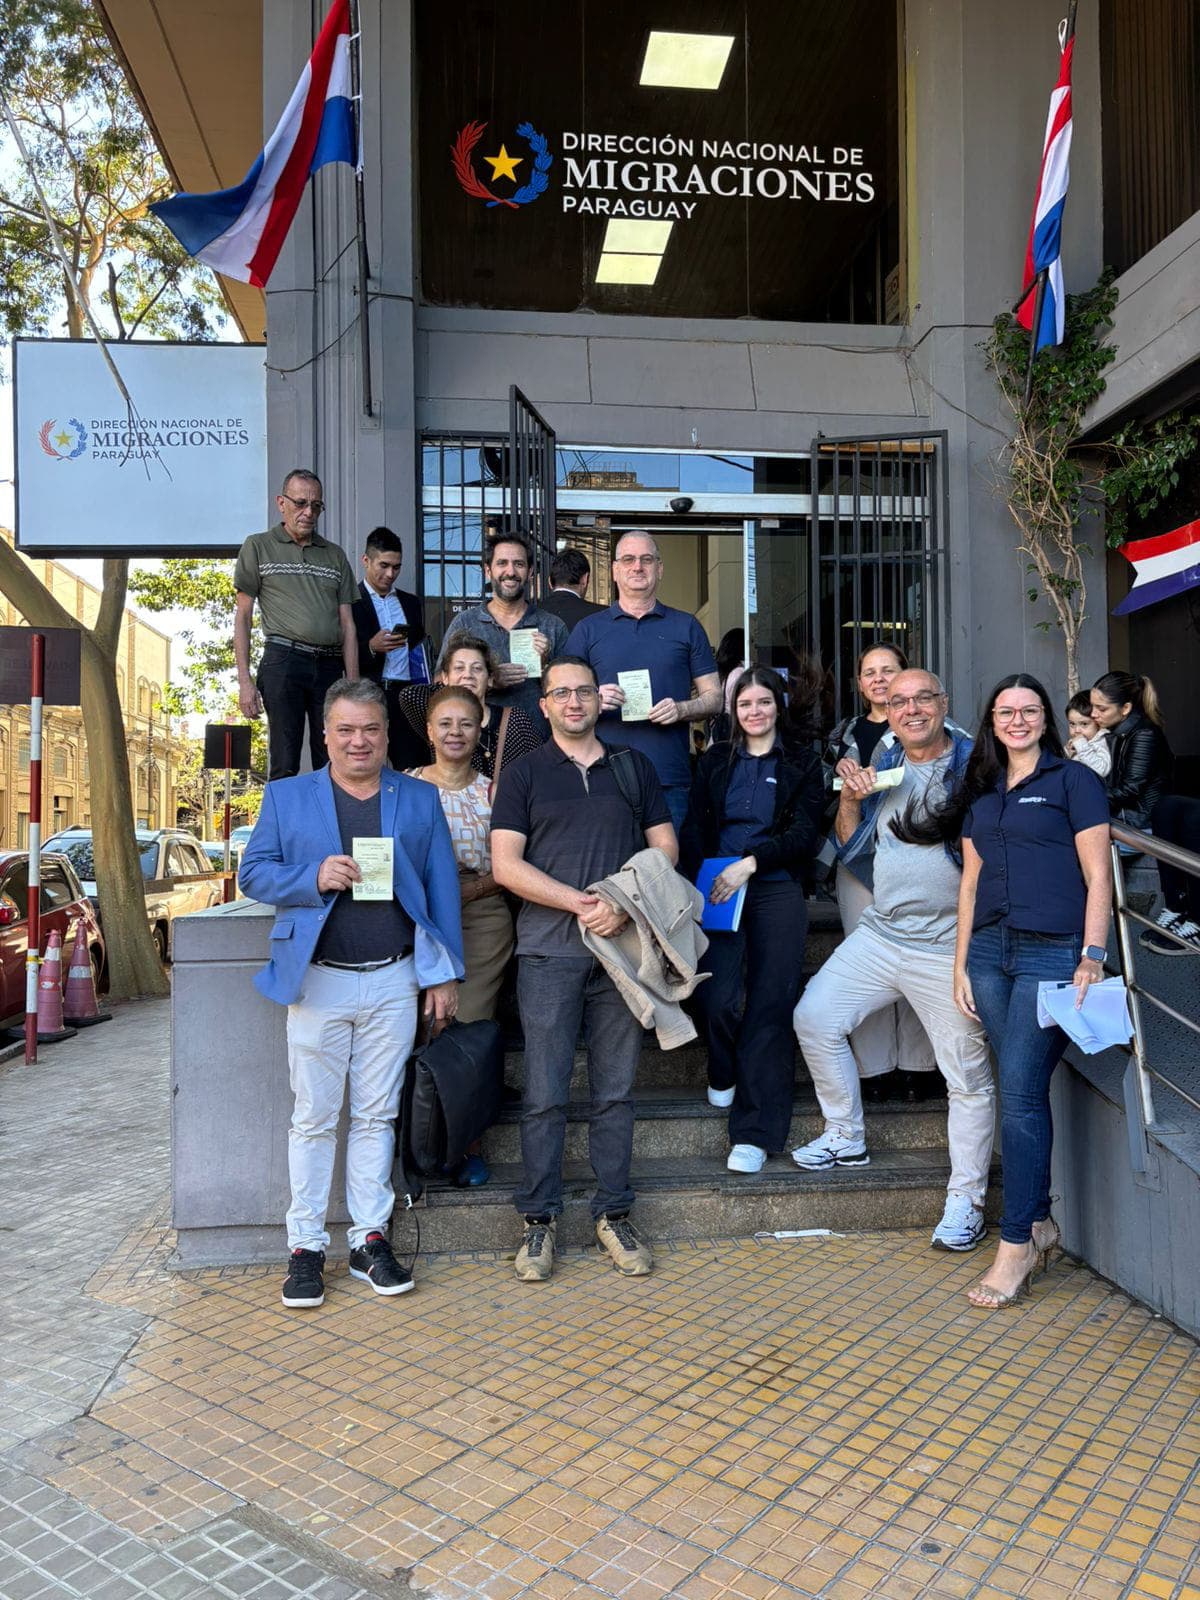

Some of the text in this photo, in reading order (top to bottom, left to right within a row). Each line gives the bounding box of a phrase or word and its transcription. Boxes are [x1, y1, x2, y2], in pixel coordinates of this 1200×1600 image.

[562, 132, 864, 166] DIRECCIÓN NACIONAL DE
[563, 157, 875, 202] MIGRACIONES
[563, 196, 697, 219] PARAGUAY
[91, 418, 243, 429] DIRECCIÓN NACIONAL DE
[92, 430, 249, 447] MIGRACIONES
[92, 450, 161, 460] PARAGUAY
